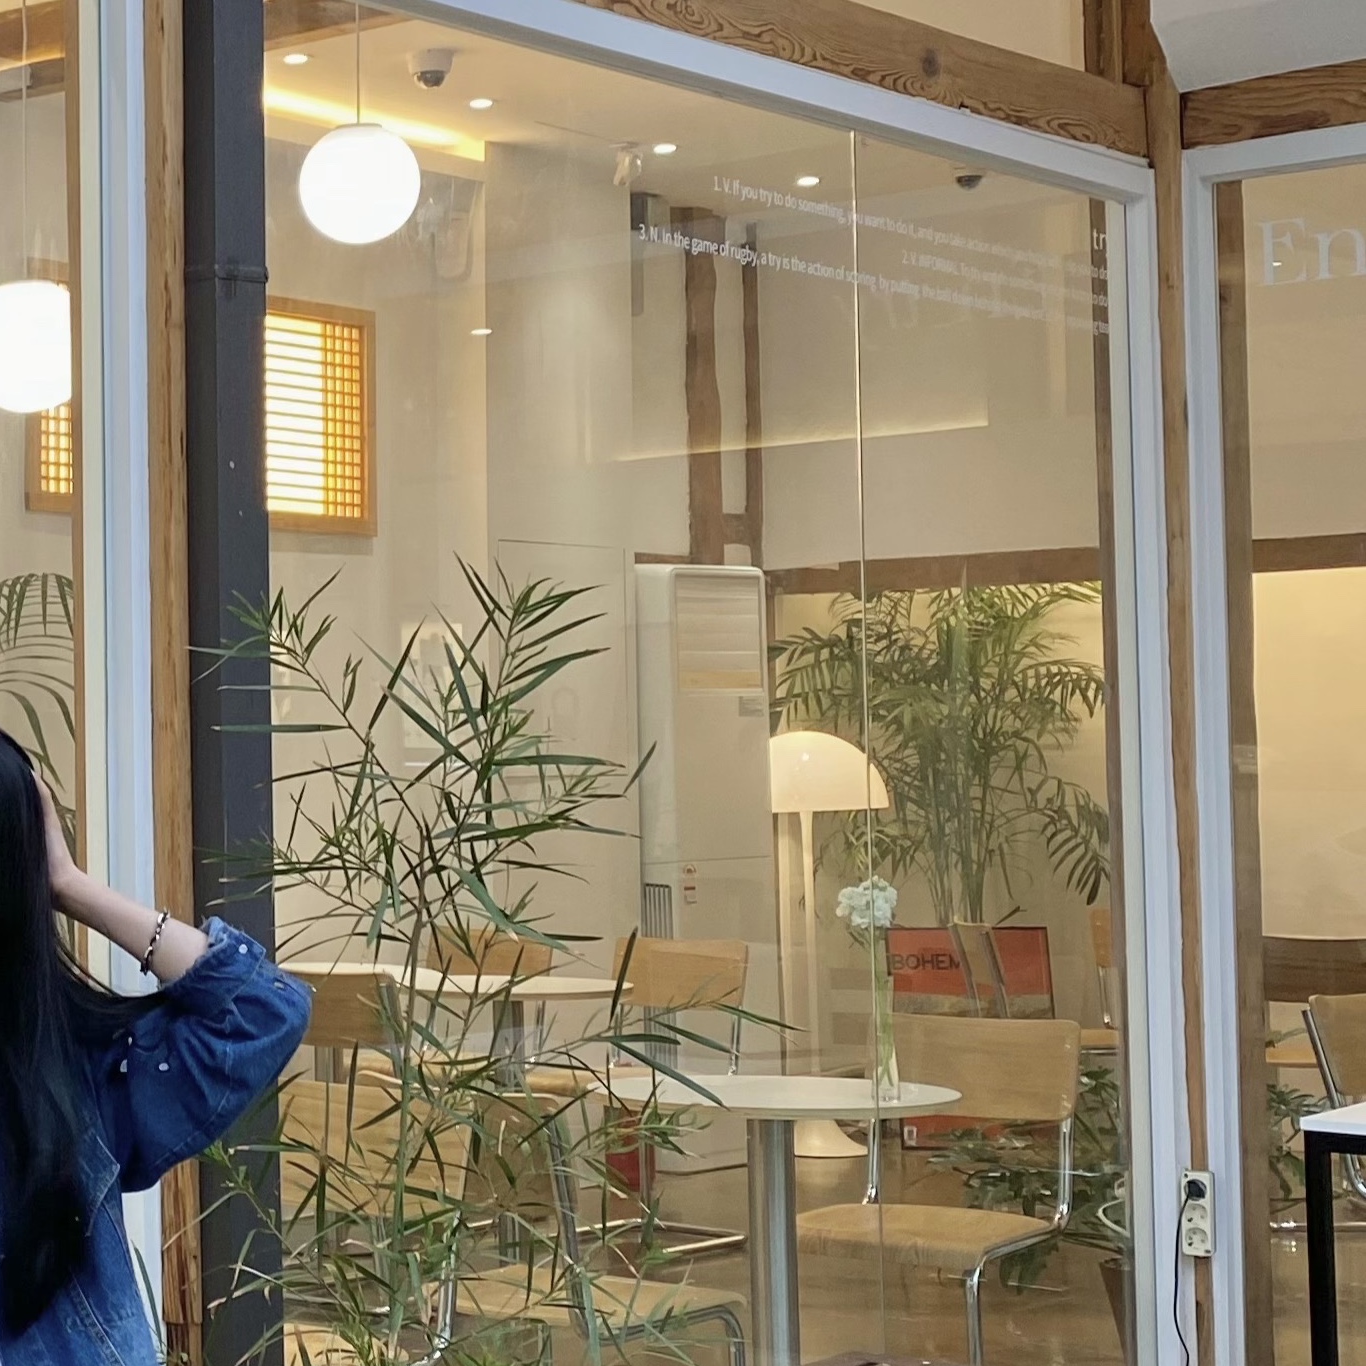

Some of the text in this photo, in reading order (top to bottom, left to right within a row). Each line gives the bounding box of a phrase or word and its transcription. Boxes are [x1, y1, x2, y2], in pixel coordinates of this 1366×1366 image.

[741, 185, 758, 201] you
[759, 188, 773, 207] try
[774, 191, 784, 206] to
[784, 192, 796, 209] do
[662, 229, 673, 245] In
[674, 230, 690, 249] the
[691, 238, 719, 255] game
[719, 240, 730, 257] of
[768, 251, 781, 272] try
[782, 253, 790, 270] is
[791, 255, 806, 272] the
